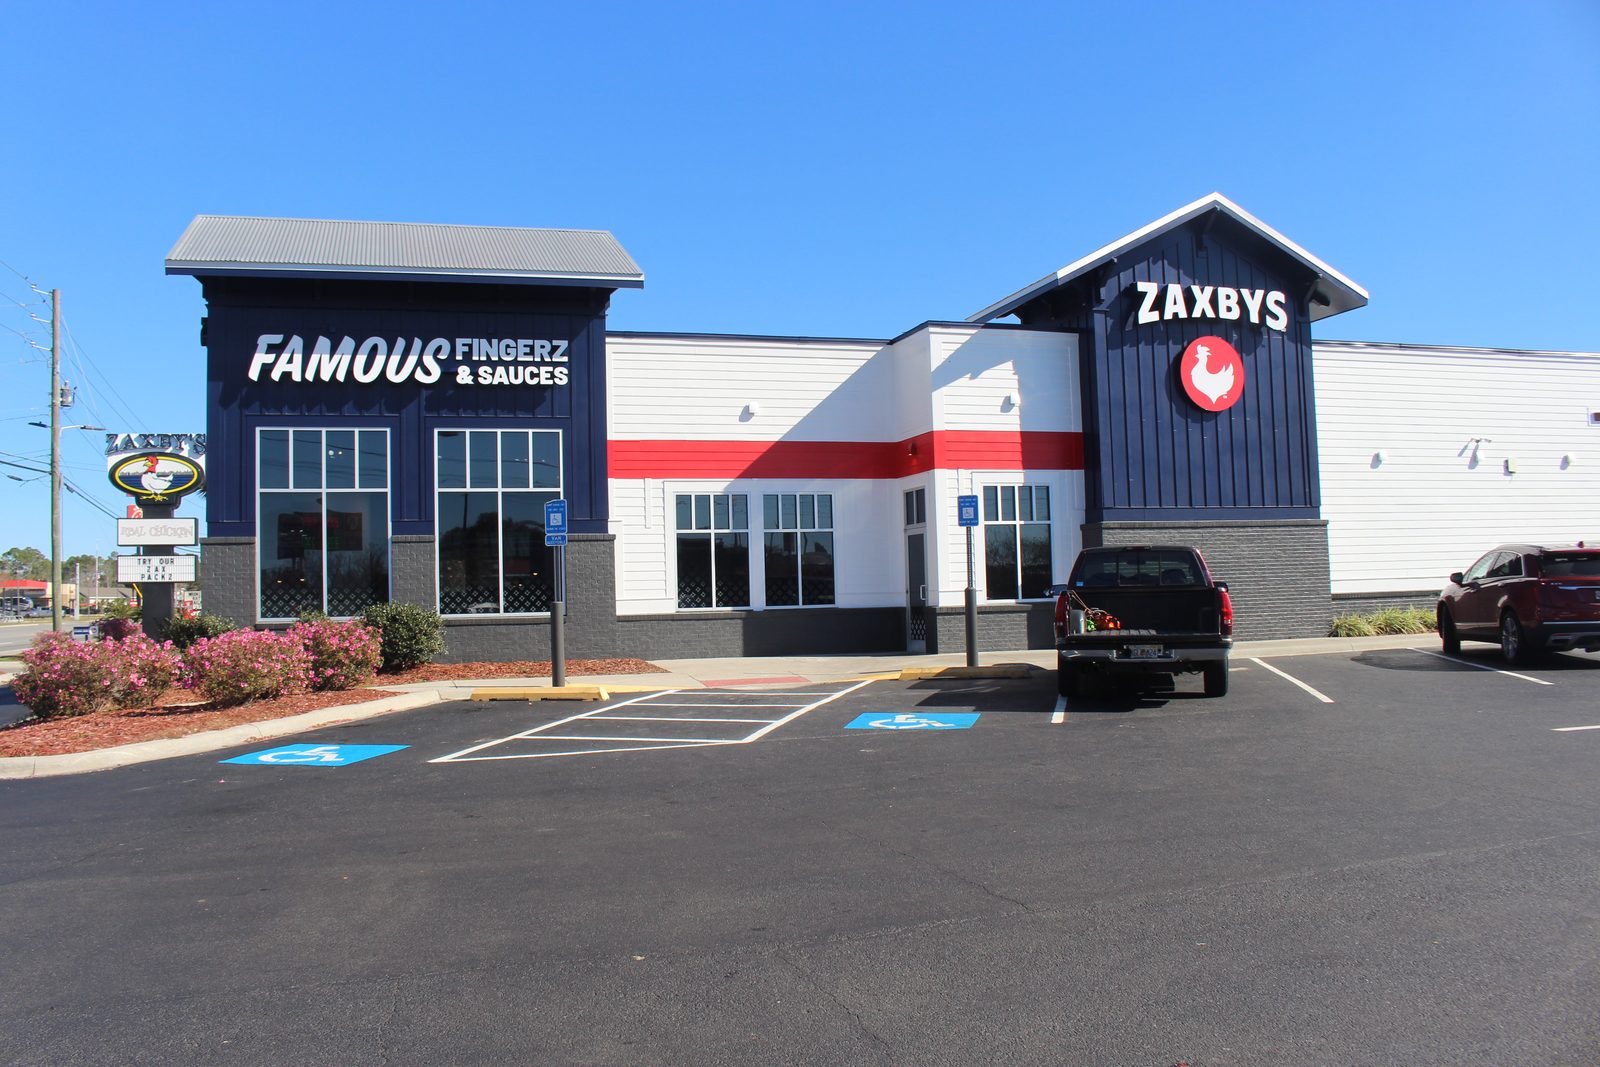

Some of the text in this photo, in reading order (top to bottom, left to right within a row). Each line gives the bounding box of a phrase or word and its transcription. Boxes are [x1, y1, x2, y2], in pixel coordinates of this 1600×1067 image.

[1137, 281, 1288, 332] ZAXBYS
[248, 334, 569, 384] FAMOUS FINGERZ
[456, 366, 569, 386] & SAUCES
[105, 433, 207, 456] ZAXBY'S
